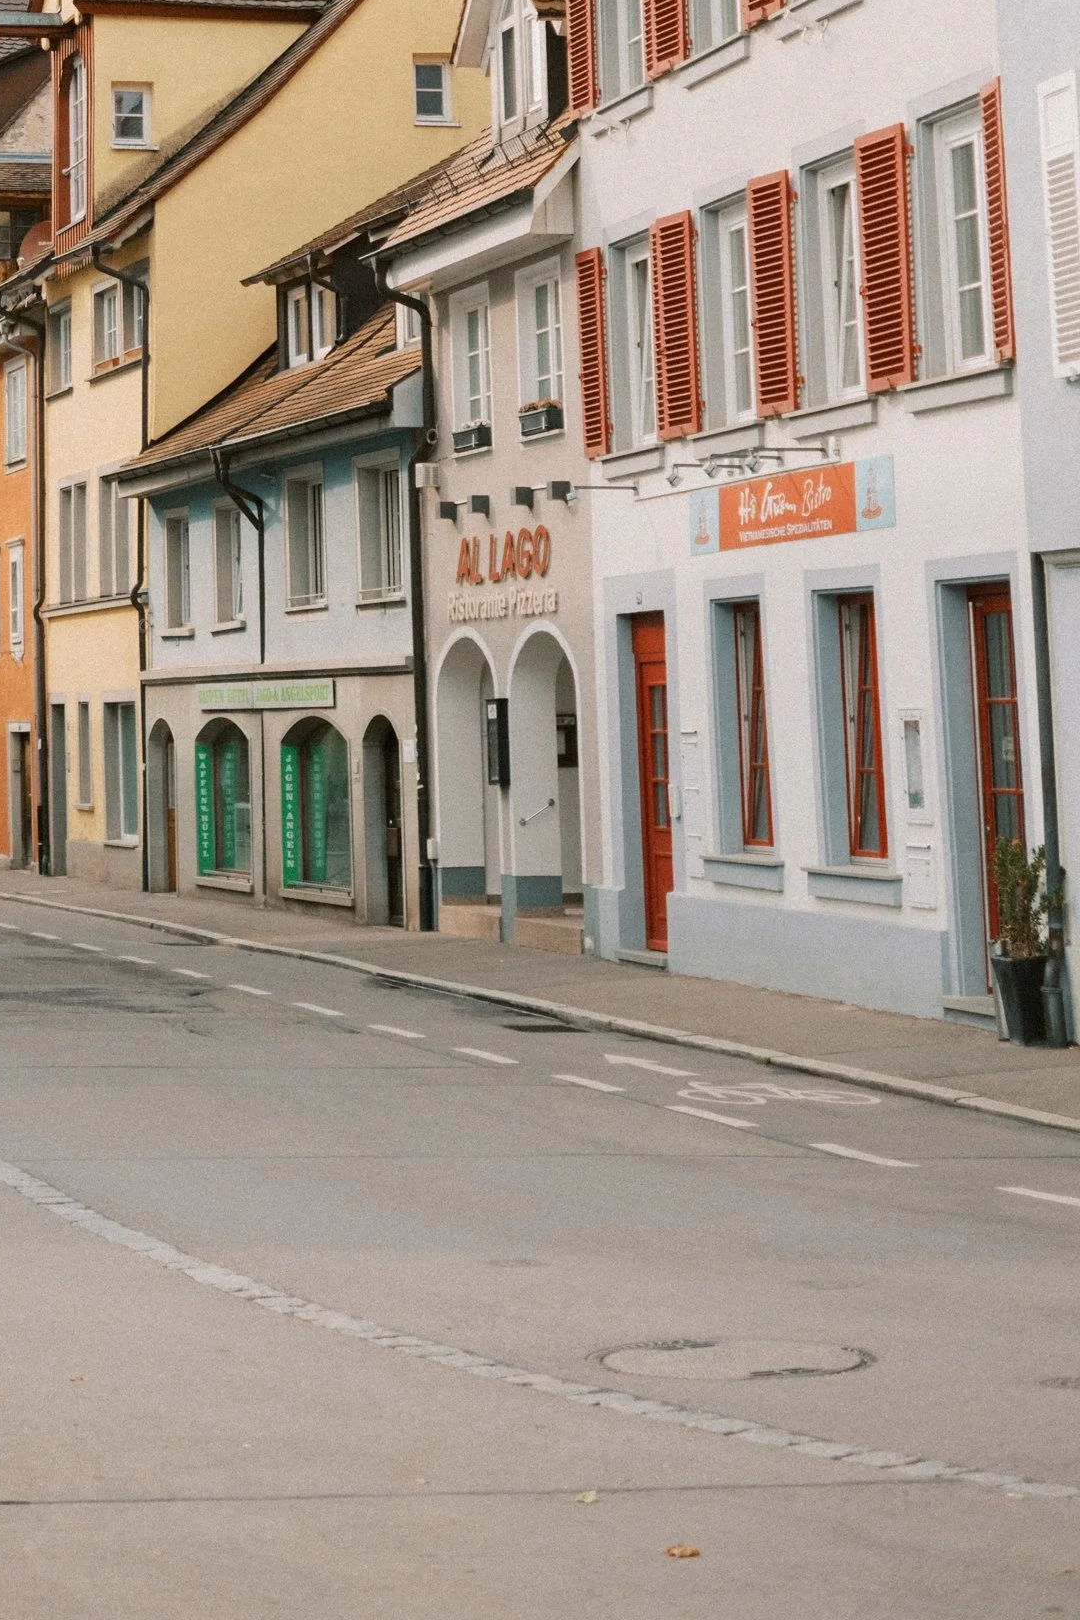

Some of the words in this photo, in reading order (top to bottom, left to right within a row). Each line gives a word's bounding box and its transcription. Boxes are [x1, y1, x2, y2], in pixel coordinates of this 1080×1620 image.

[802, 472, 832, 517] Bistro
[456, 537, 482, 584] AL
[489, 524, 551, 582] LAGO
[448, 592, 507, 621] Ristorante
[508, 586, 558, 617] Pizzeria
